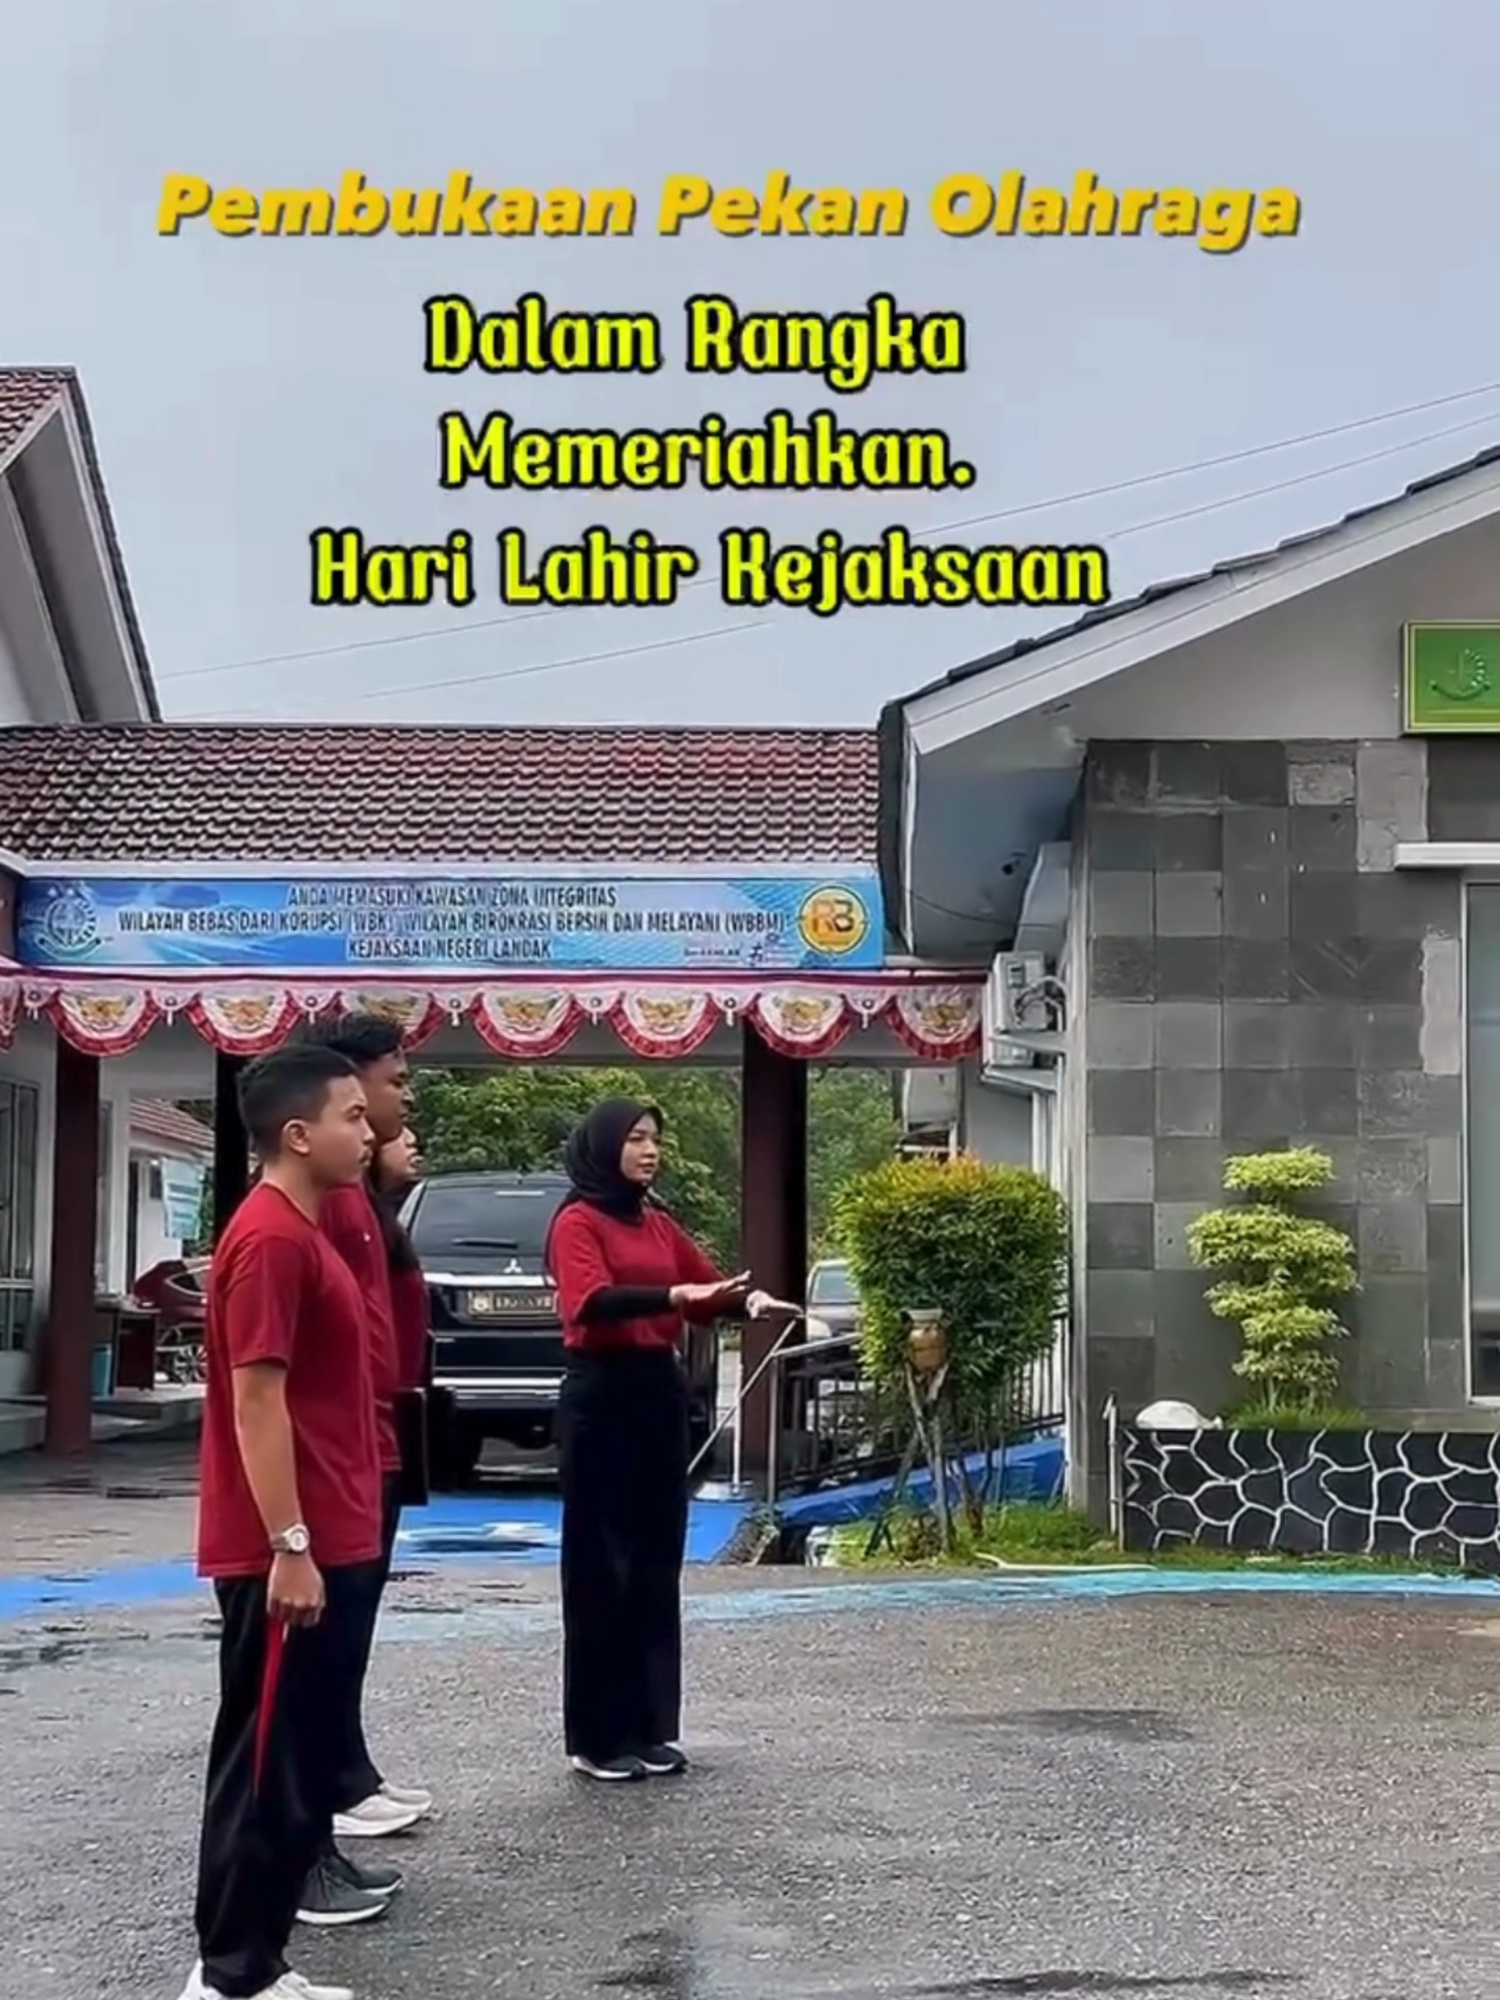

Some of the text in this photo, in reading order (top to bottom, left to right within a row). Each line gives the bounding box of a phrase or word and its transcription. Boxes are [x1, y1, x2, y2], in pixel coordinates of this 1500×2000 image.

[288, 886, 617, 908] ANDA MEMASUKI KAWASAN ZONA INTEGRITAS
[118, 910, 184, 932] WILAYAH
[188, 910, 236, 932] BEBAS
[240, 911, 275, 932] DARI
[279, 911, 343, 932] KORUPSI
[471, 911, 552, 932] BIROKRASI
[556, 911, 609, 933] BERSIH
[613, 911, 644, 933] DAN
[648, 911, 721, 933] MELAYANI
[725, 911, 785, 934] (WBBM)
[349, 937, 552, 959] KEJAKSAAN NEGERI LANDAK
